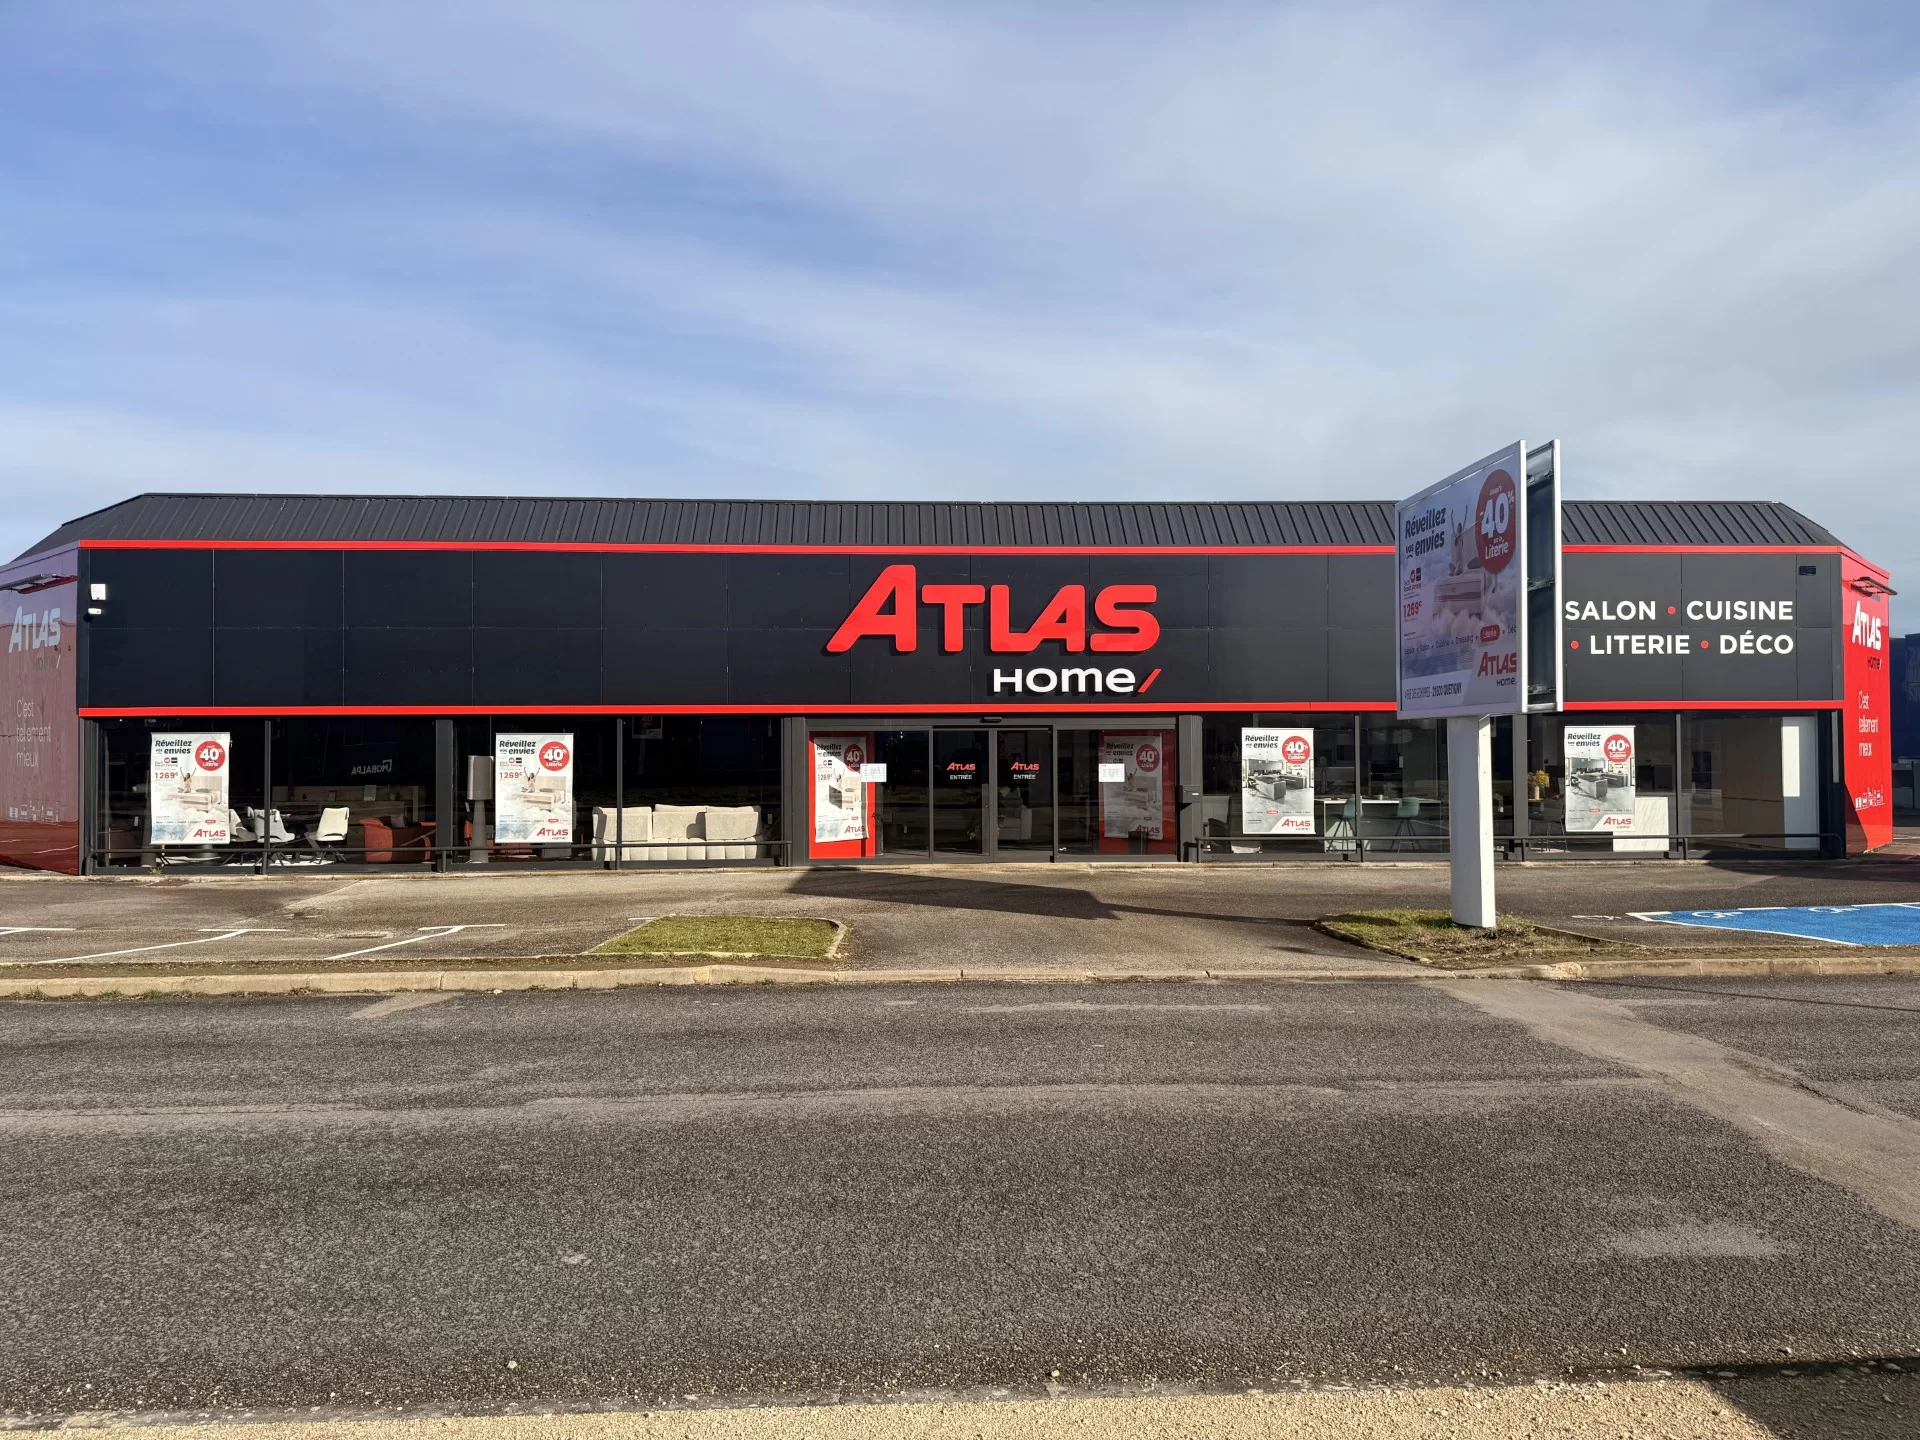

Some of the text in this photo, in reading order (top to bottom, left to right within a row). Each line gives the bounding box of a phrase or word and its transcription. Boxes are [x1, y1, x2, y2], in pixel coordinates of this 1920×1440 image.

[1405, 507, 1446, 539] Réveillez
[1415, 530, 1445, 556] envies
[1485, 542, 1508, 560] Literie
[826, 564, 1160, 652] ATLAS
[1565, 600, 1793, 620] SALON CUISINE
[8, 606, 60, 653] ATLAS
[1852, 600, 1882, 650] ATLAS
[1590, 630, 1794, 654] LITERIE DÉCO
[1478, 652, 1516, 677] ATLAS
[16, 698, 34, 718] C'est
[17, 747, 38, 767] mieux
[947, 762, 976, 770] ATLAS
[1010, 762, 1039, 770] ATLAS
[845, 826, 865, 834] ATLAS
[1136, 825, 1160, 833] ATLAS
[1282, 819, 1310, 827] ATLAS
[1603, 817, 1631, 825] ATLAS
[194, 829, 226, 838] ATLAS
[537, 828, 568, 836] ATLAS
